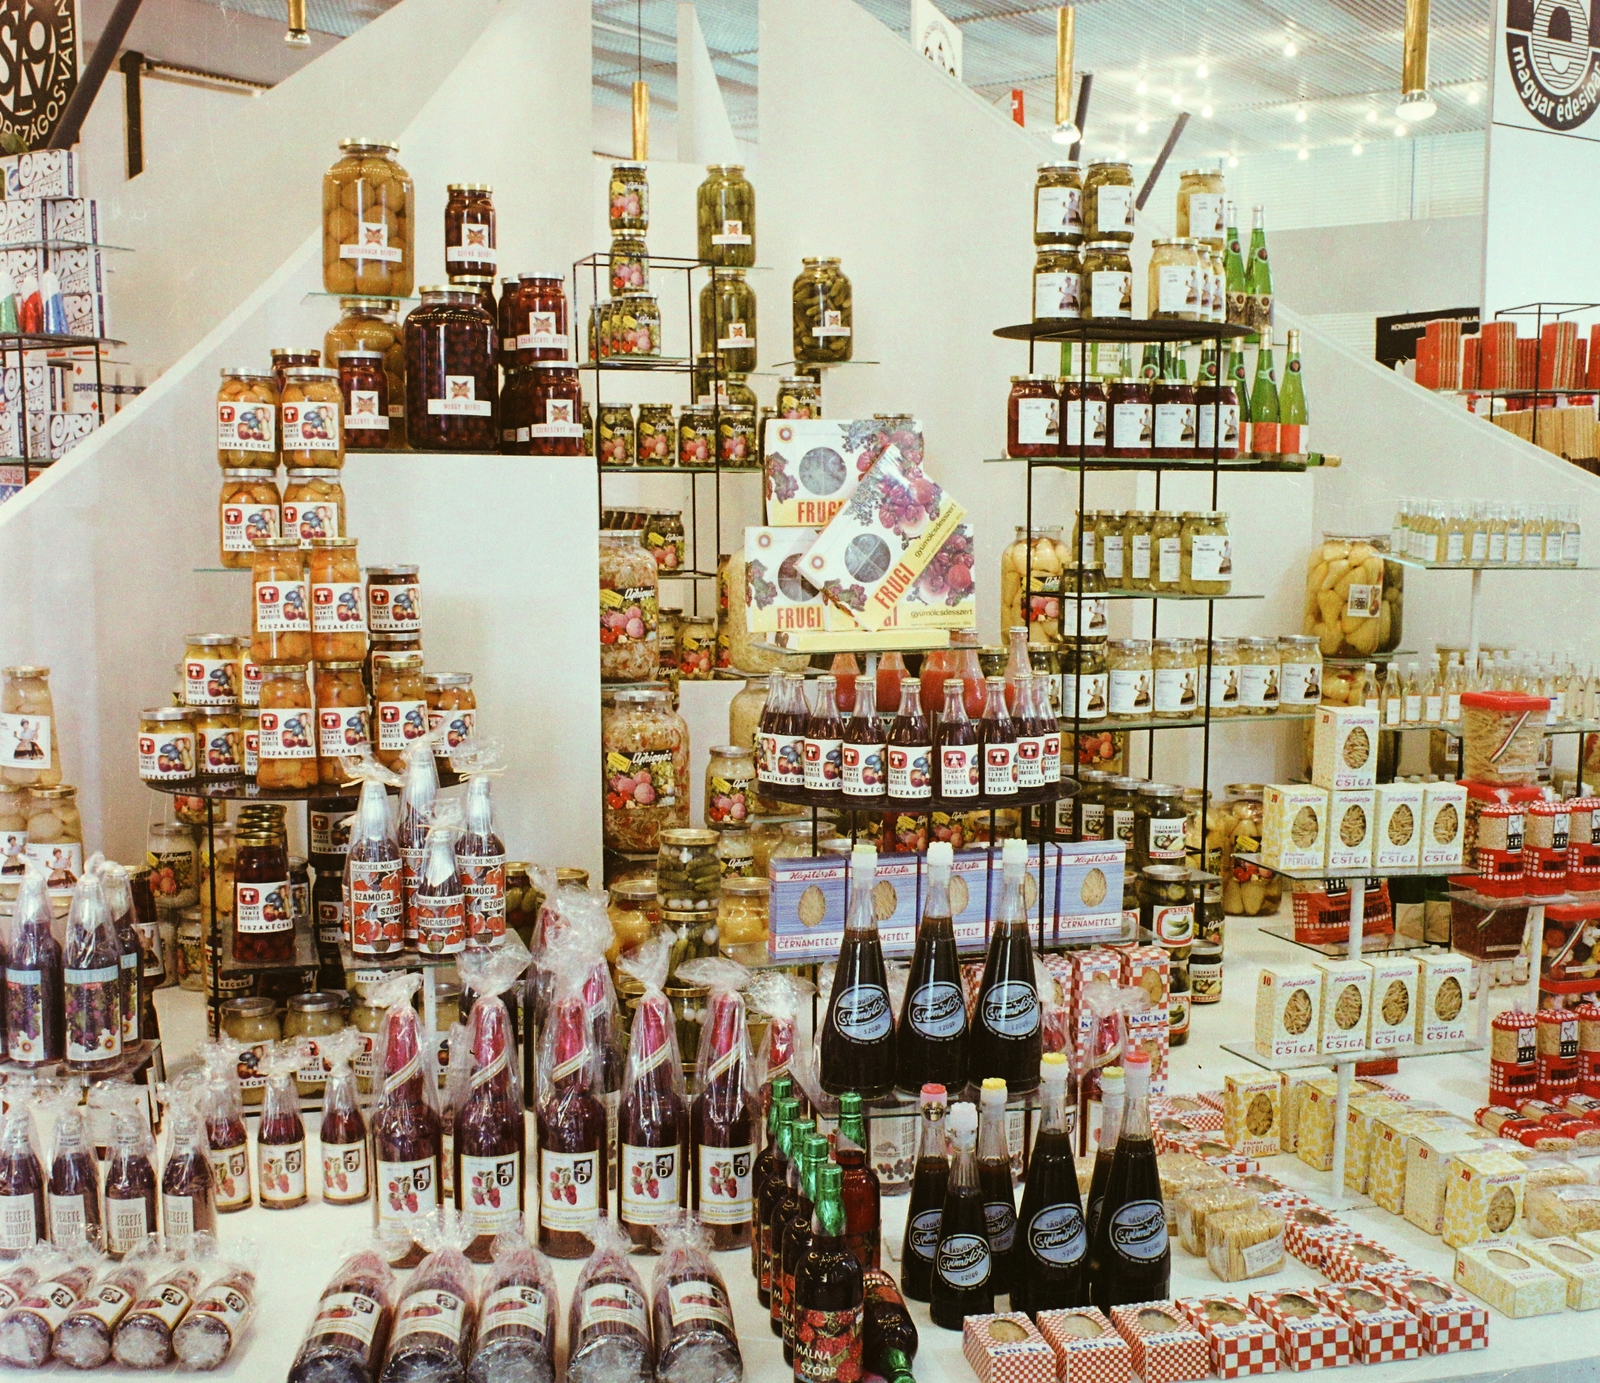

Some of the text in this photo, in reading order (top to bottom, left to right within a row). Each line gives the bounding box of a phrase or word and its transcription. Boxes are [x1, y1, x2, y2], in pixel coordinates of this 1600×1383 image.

[1512, 46, 1555, 118] magyar
[0, 85, 66, 144] RSZÁGOS
[797, 501, 843, 523] FRUG
[873, 562, 916, 610] FRUGI
[777, 606, 821, 629] FRUGI
[1335, 779, 1373, 787] CSIGA
[1379, 856, 1415, 864] CSIGA
[1424, 854, 1460, 862] CSIGA
[352, 863, 378, 872] TOKODI
[354, 891, 391, 901] SZAMÓCA
[420, 917, 461, 927] MÓCASZÖRP
[1060, 917, 1118, 929] CÉRNAMETÉLT
[880, 932, 909, 942] METÉLT
[777, 937, 839, 949] CÉRNAMETÉLT
[1131, 1013, 1168, 1023] KOCKA
[1375, 1035, 1413, 1045] CSIGA
[1427, 1030, 1465, 1040] CSIGA
[1326, 1040, 1365, 1049] CSIGA
[1275, 1045, 1315, 1055] CSIGA
[1418, 1148, 1429, 1160] 20
[234, 1167, 241, 1175] D
[289, 1164, 297, 1173] D
[348, 1163, 355, 1172] D
[659, 1167, 668, 1177] D
[737, 1167, 745, 1176] D
[500, 1176, 509, 1184] D
[577, 1174, 587, 1184] D
[1461, 1169, 1471, 1182] 20
[418, 1181, 426, 1190] D
[1069, 1339, 1123, 1351] KOCKA
[795, 1343, 831, 1361] MÁLNA
[993, 1345, 1047, 1356] KOCKA
[800, 1361, 837, 1377] SZÖRP
